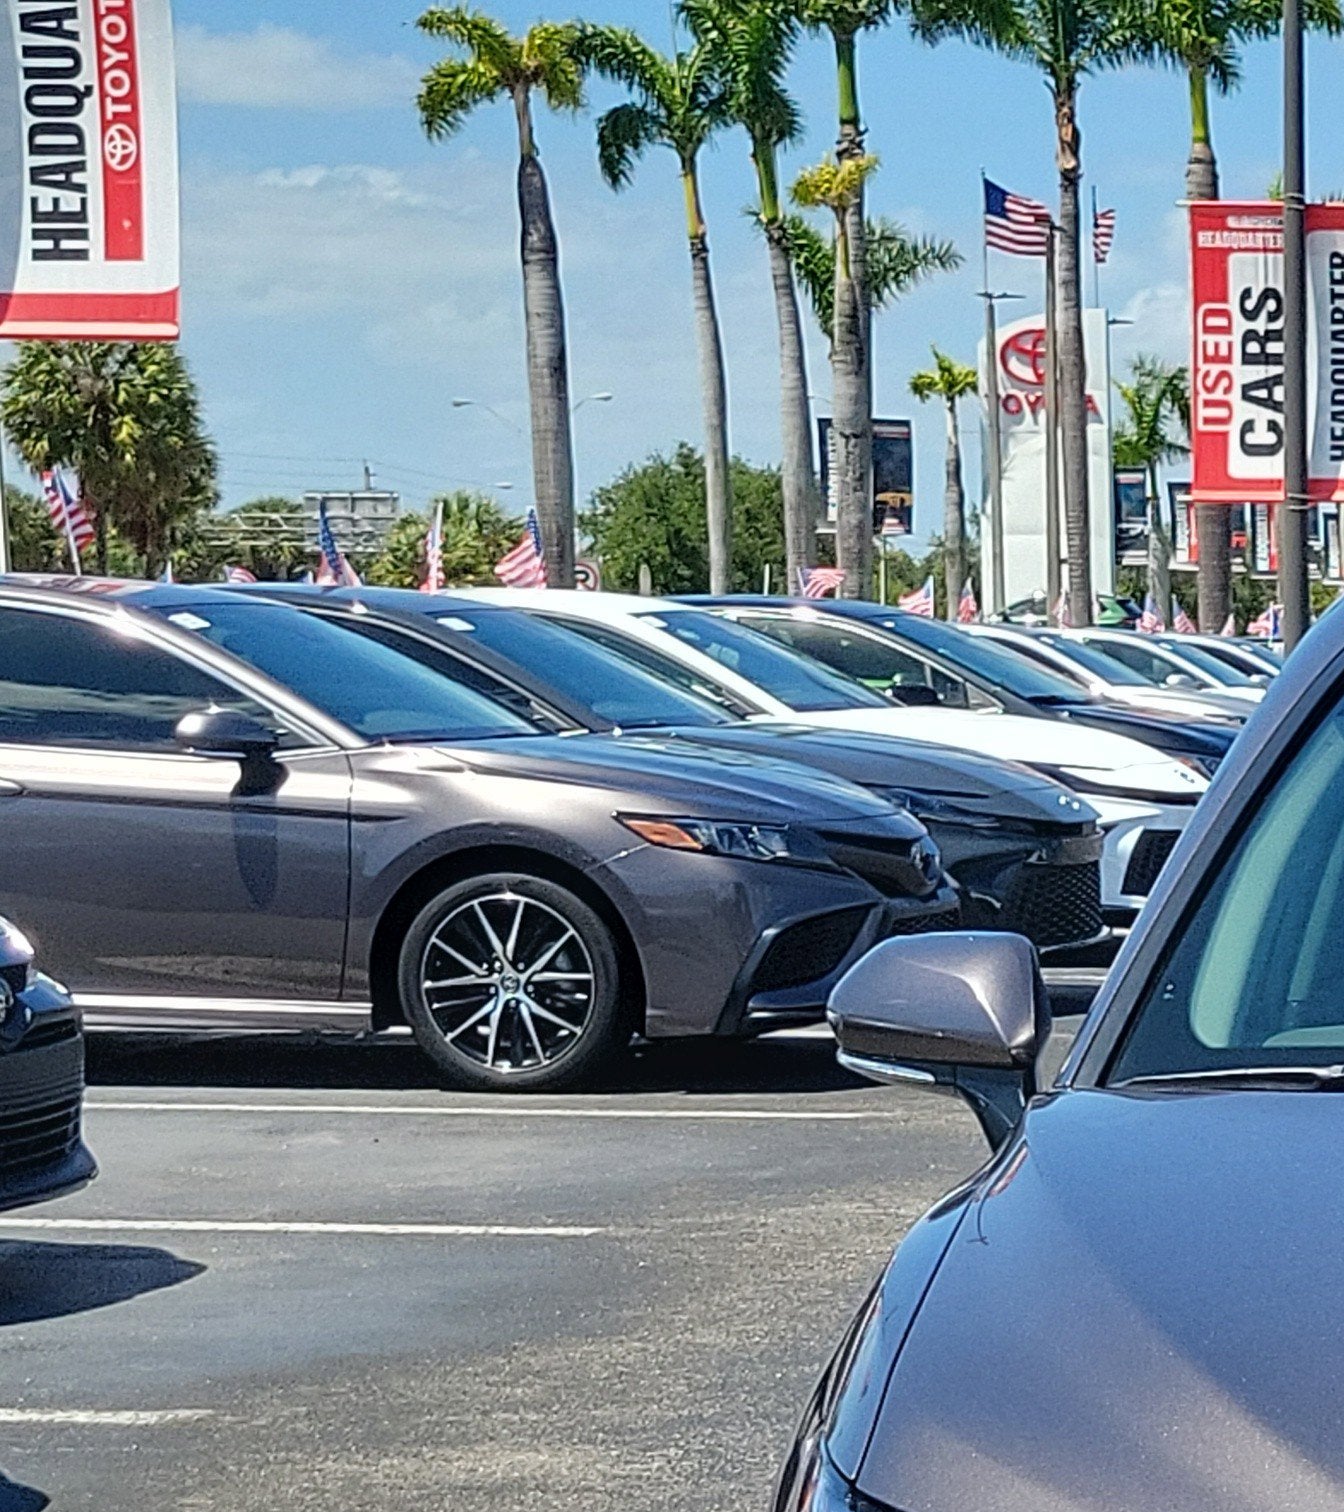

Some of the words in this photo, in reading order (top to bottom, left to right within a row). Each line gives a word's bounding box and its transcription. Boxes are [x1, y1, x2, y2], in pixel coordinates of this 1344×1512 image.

[18, 0, 93, 261] HEADQUA
[1201, 307, 1234, 426] USED
[1240, 286, 1284, 457] CARS
